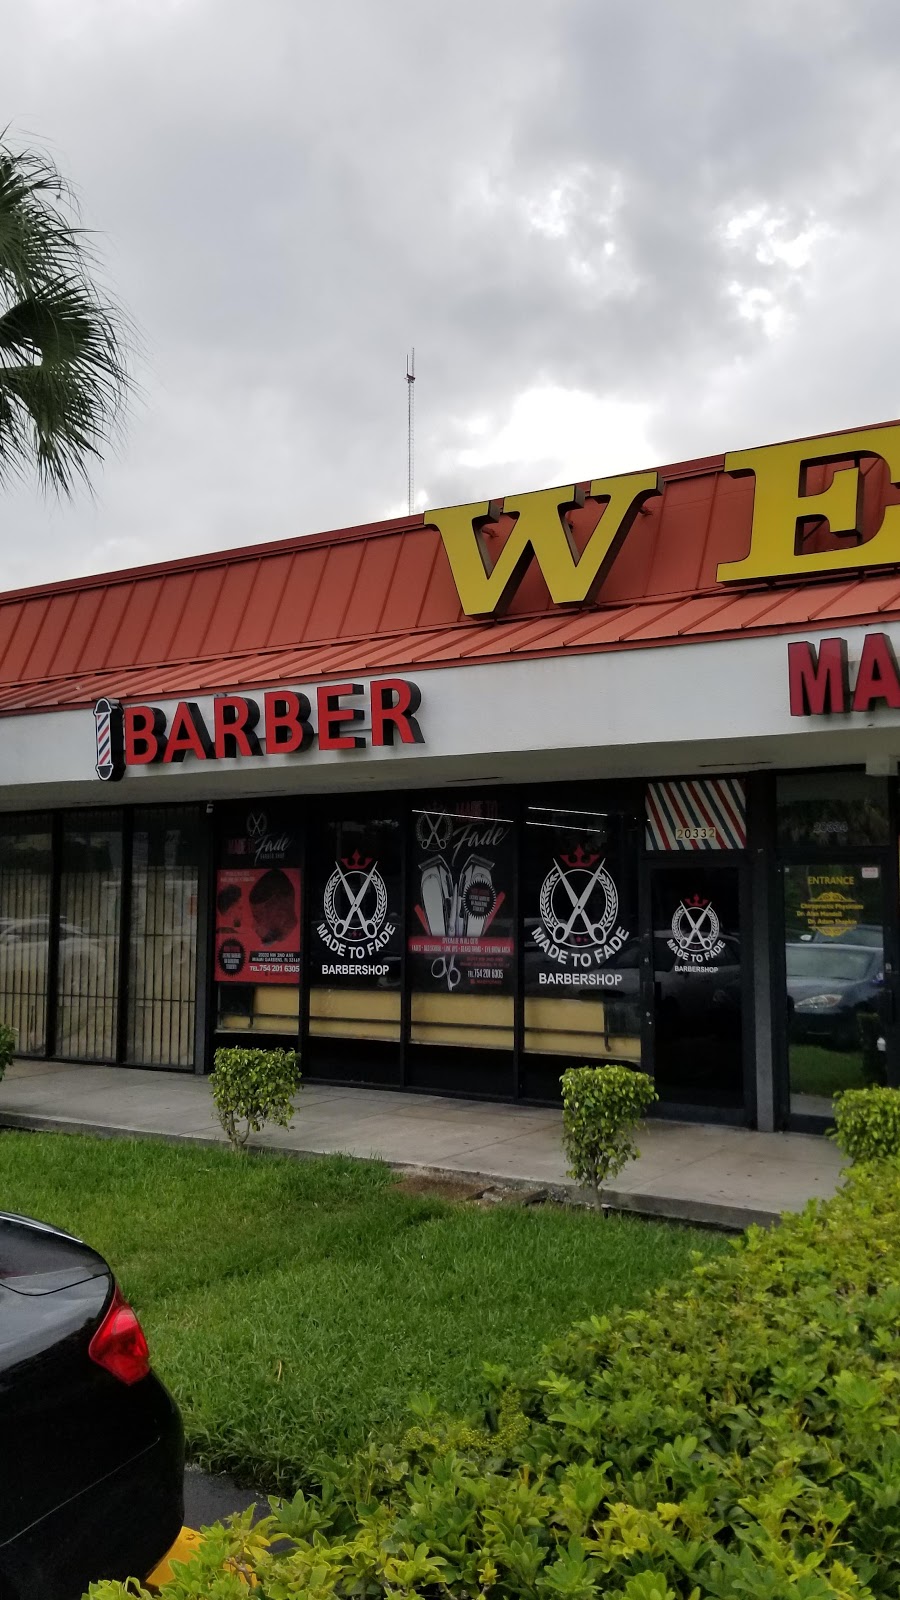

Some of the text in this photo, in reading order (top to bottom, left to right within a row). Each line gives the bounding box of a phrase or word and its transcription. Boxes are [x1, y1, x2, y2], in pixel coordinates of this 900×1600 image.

[787, 632, 900, 716] MA
[124, 678, 424, 766] BARBER
[677, 828, 715, 839] 20332
[255, 832, 294, 866] Fade
[452, 821, 511, 867] Fade
[808, 876, 855, 885] ENTRANCE
[316, 922, 396, 959] MADE TO FADE
[531, 926, 630, 967] MADE TO FADE
[666, 939, 726, 962] MADE TO FADE
[284, 965, 300, 973] 6305
[321, 964, 389, 976] BARBERSHOP
[483, 969, 491, 978] 201
[674, 965, 719, 973] BARBERSHOP
[538, 973, 623, 986] BARBERSHOP
